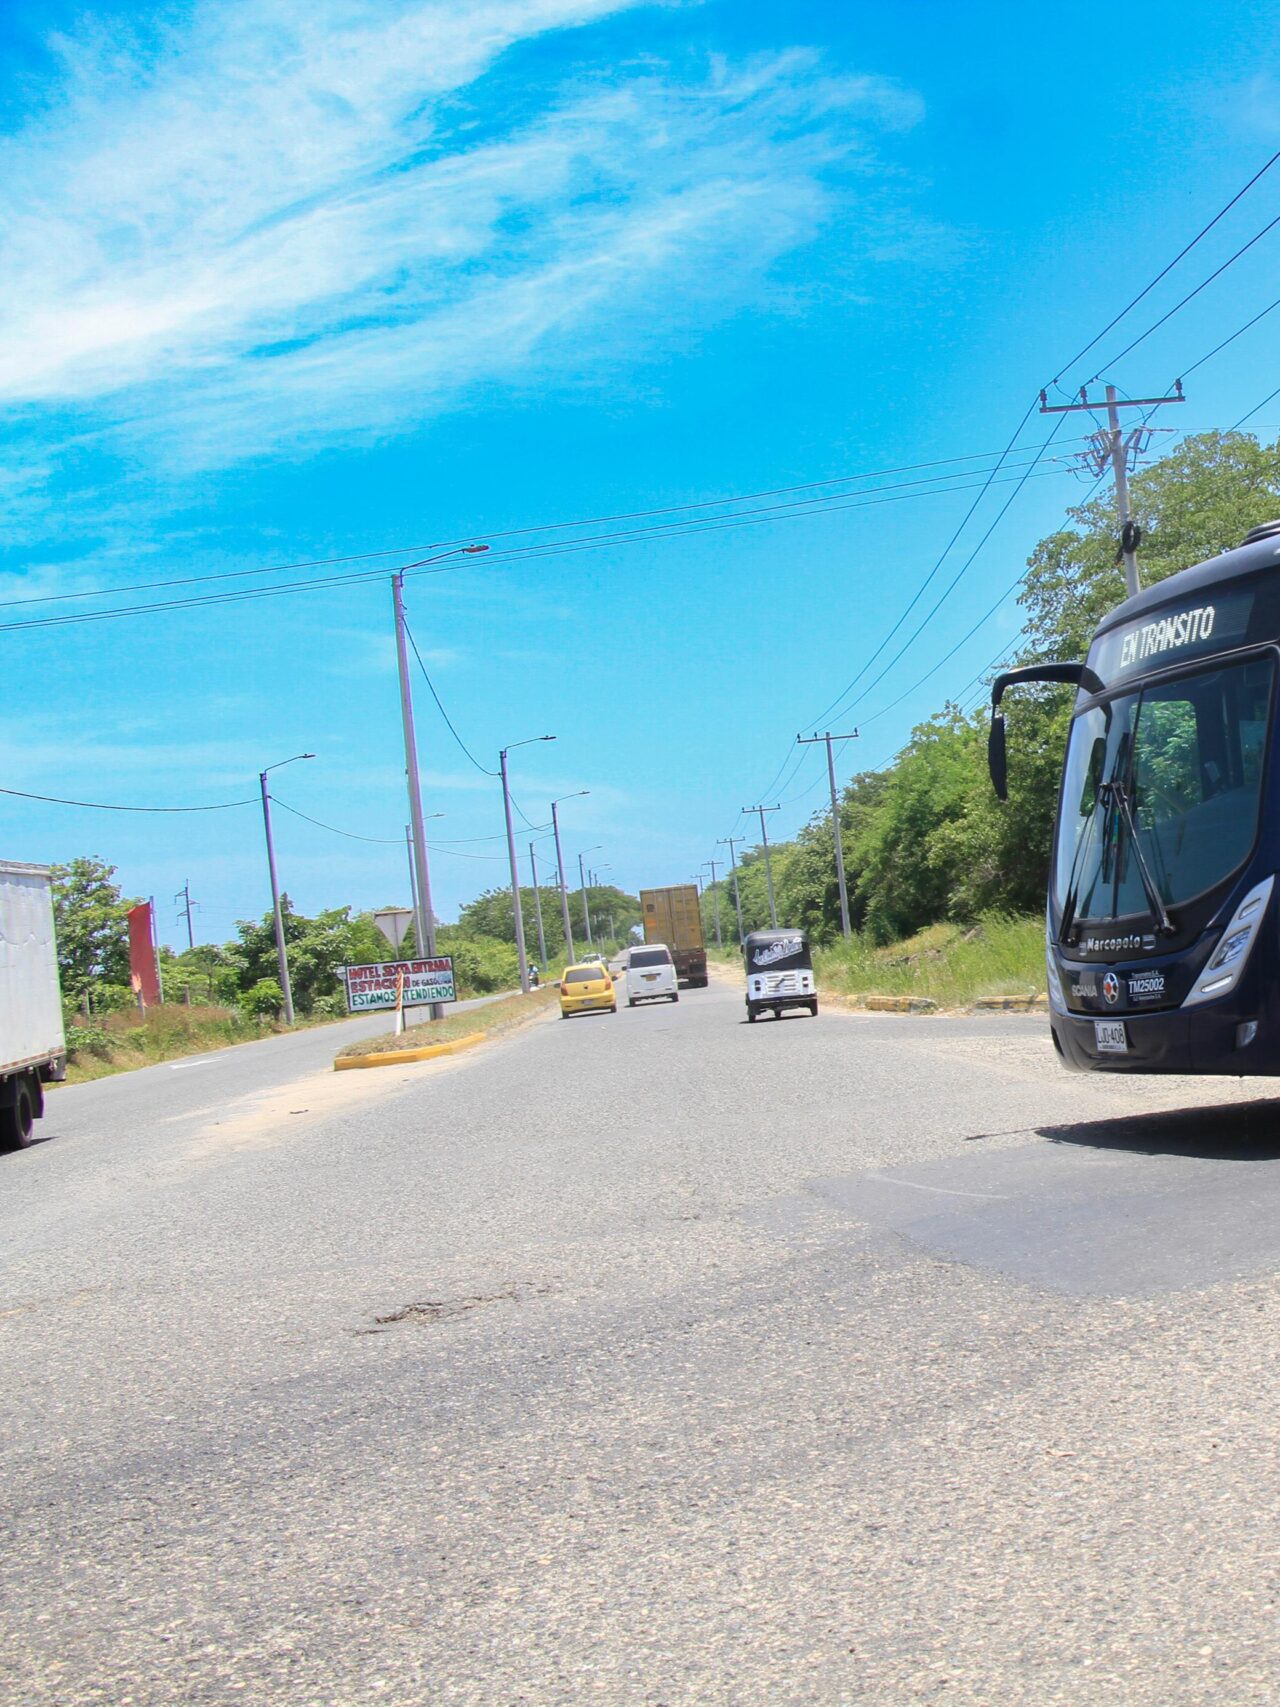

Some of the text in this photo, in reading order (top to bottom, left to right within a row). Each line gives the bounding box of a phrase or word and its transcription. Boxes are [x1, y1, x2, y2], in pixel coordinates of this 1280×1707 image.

[1120, 605, 1215, 668] EN TRANSITO
[1087, 934, 1140, 951] Marcopolo
[348, 966, 381, 981] HOTEL
[411, 959, 450, 974] ENTRADA
[411, 979, 421, 987] DE
[1071, 984, 1098, 997] SCANIA
[1128, 977, 1165, 994] TM25002
[352, 991, 397, 1006] ESTAMOS
